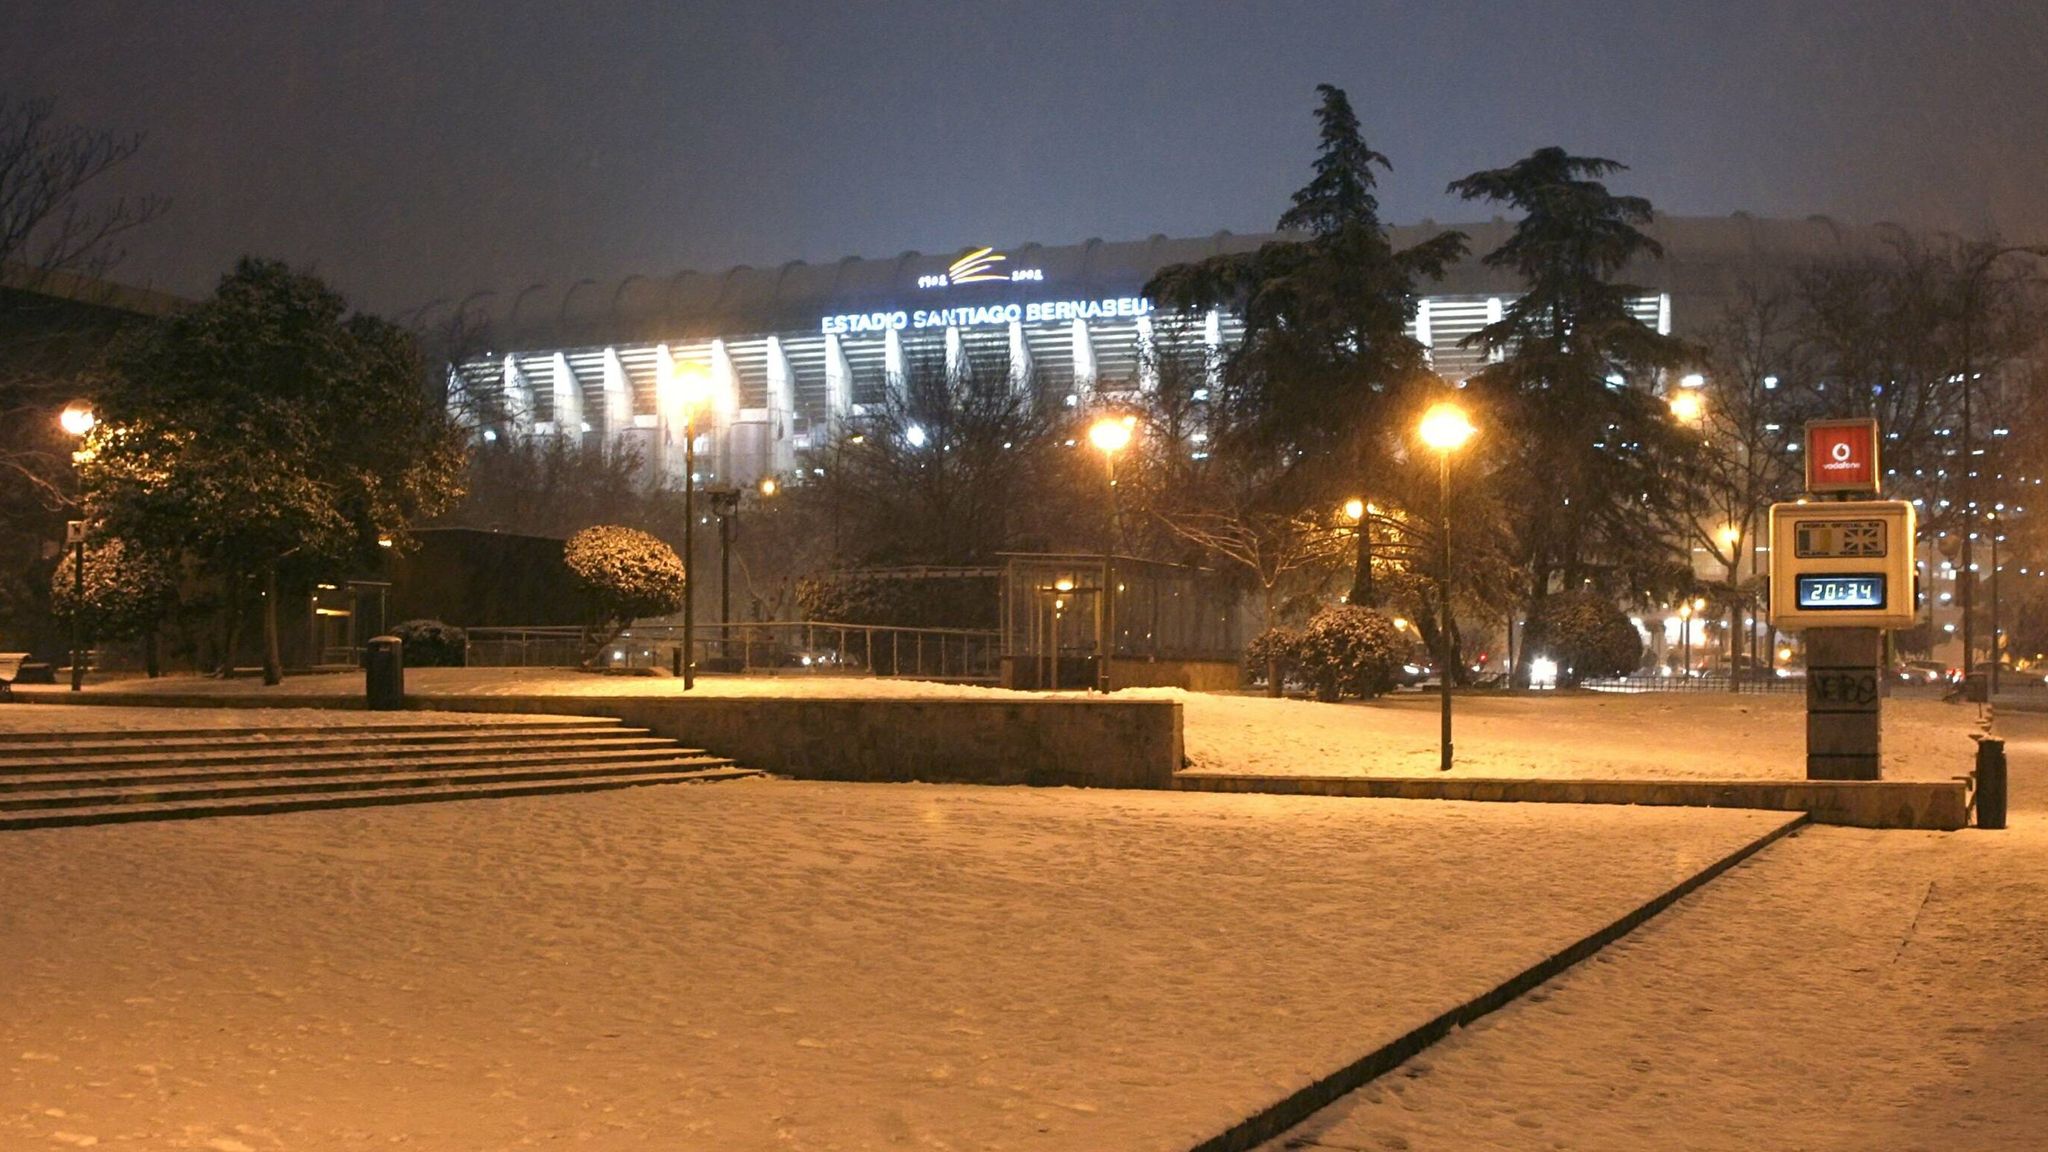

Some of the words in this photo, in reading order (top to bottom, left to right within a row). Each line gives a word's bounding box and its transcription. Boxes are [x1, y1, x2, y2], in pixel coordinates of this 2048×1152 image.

[918, 274, 948, 289] 1902
[1011, 269, 1044, 282] 2002
[821, 310, 908, 335] ESTADIO
[913, 303, 1022, 329] SANTIAGO
[1026, 297, 1149, 323] BERNABEU
[1823, 461, 1861, 471] vodafone
[1810, 583, 1872, 601] 20:34
